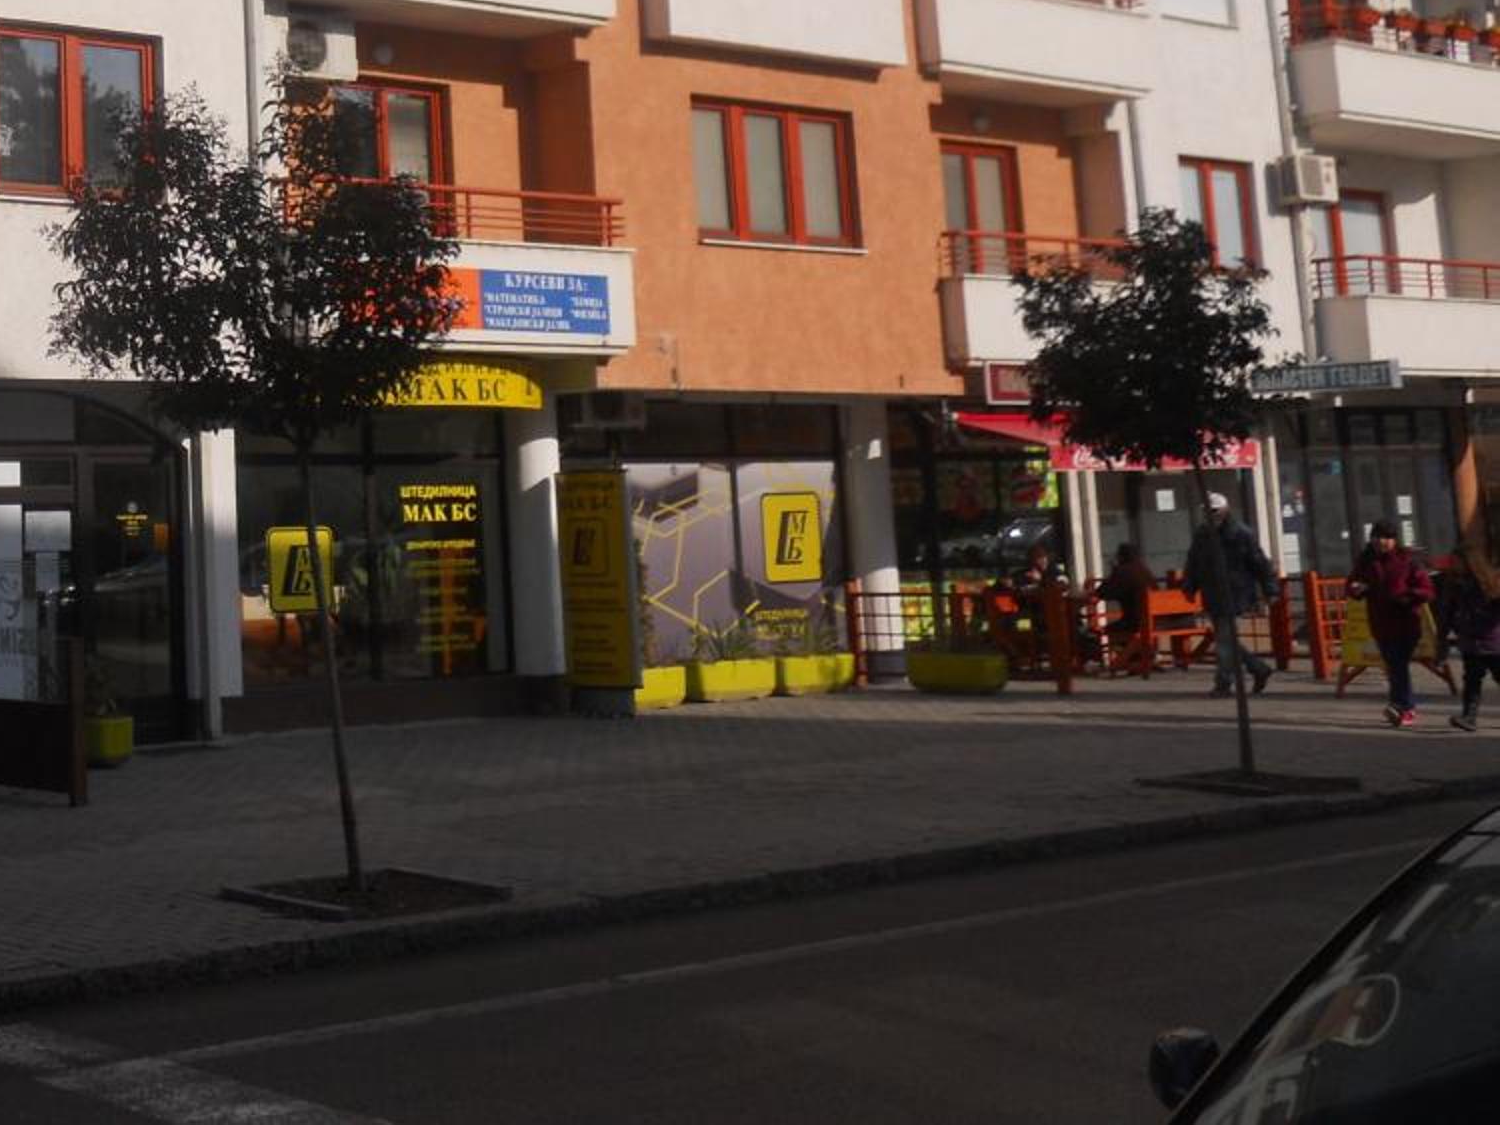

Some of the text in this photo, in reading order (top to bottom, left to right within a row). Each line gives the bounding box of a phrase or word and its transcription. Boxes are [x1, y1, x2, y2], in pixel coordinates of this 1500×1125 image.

[504, 272, 565, 290] КУРСЕВИ
[477, 378, 507, 402] БС
[400, 485, 477, 500] ШТЕДИЛНИЦА
[403, 502, 477, 523] МАК БС
